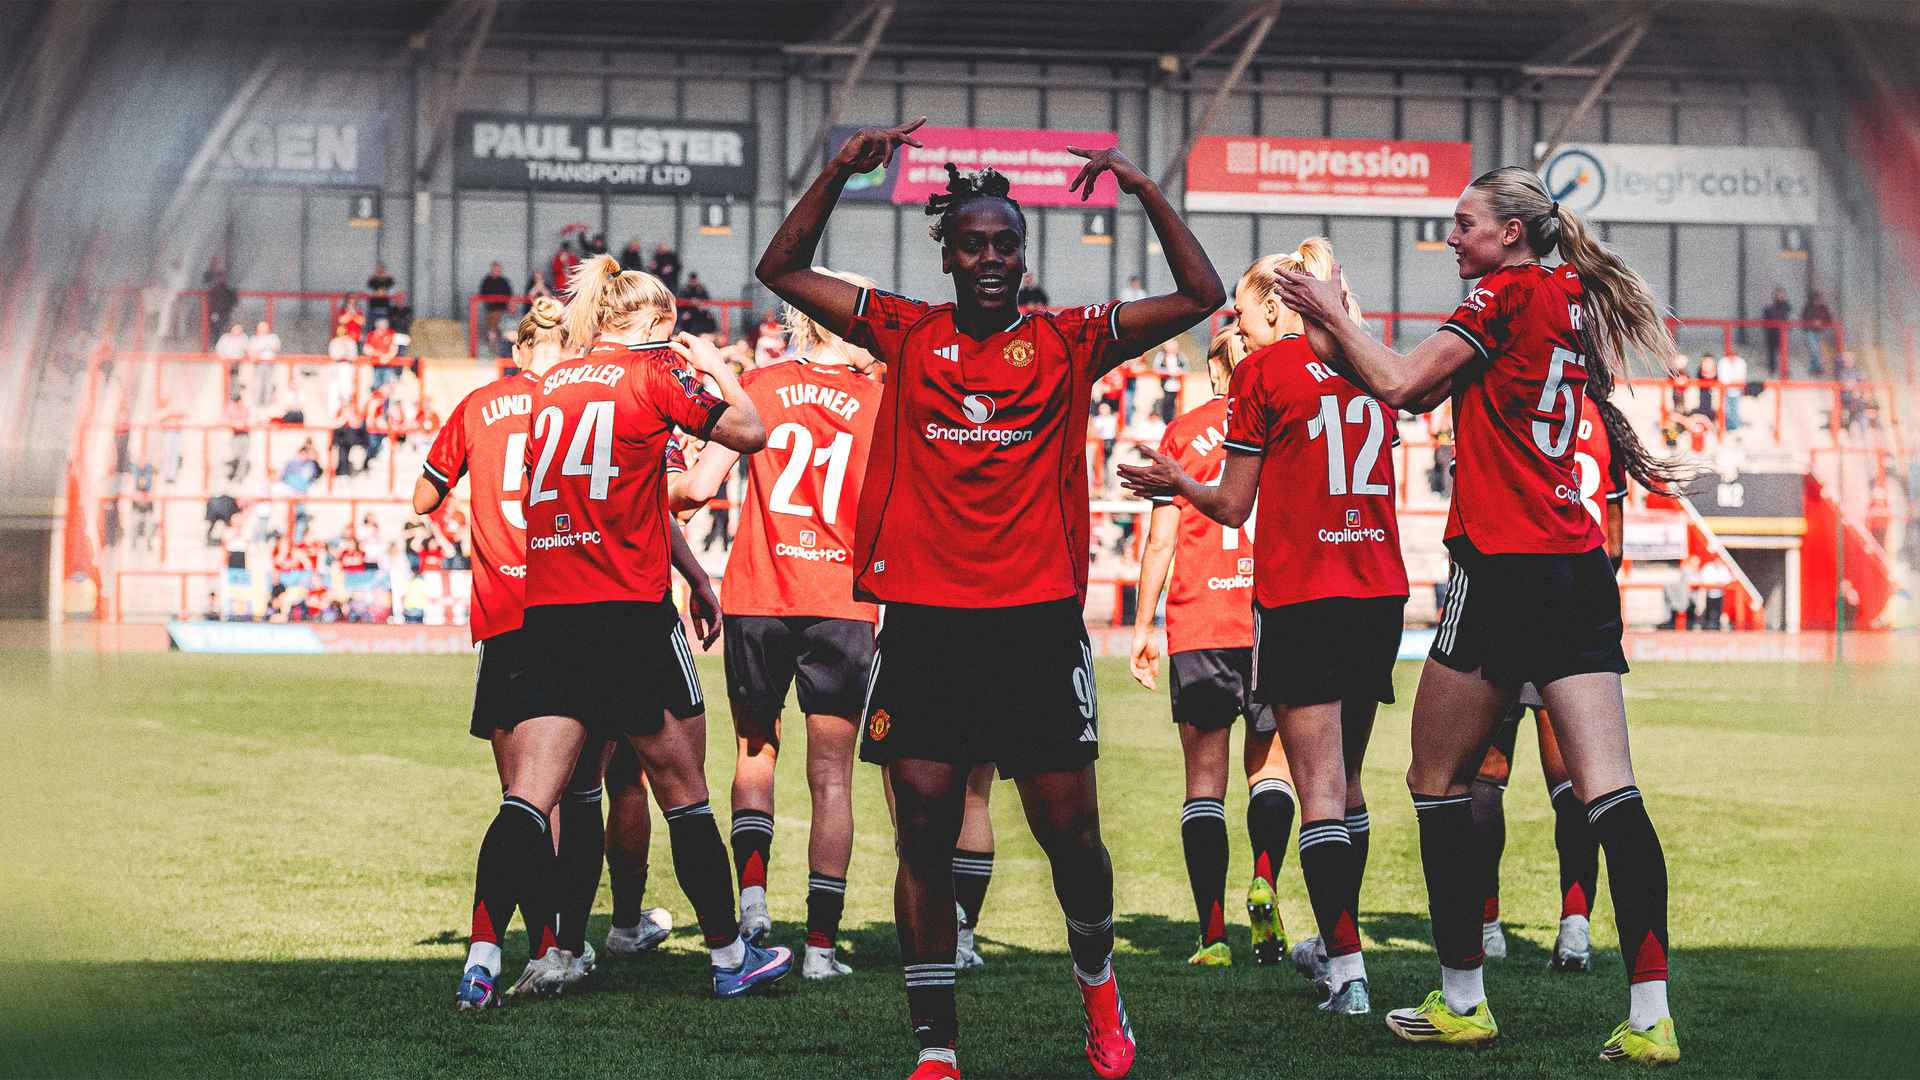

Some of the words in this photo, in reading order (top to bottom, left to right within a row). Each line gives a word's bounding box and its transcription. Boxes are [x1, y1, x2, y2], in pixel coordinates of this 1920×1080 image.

[473, 122, 582, 159] PAUL
[587, 126, 744, 167] LESTER
[527, 160, 648, 184] TRANSPORT
[652, 164, 692, 185] LTD
[481, 394, 532, 426] LUND
[776, 383, 860, 421] TURNER
[1532, 346, 1585, 458] 5
[530, 400, 619, 508] 24
[926, 423, 1032, 446] Snapdragon
[1307, 394, 1390, 497] 12
[767, 422, 853, 525] 21
[530, 530, 602, 550] Copilot+PC
[1072, 666, 1094, 719] 9
